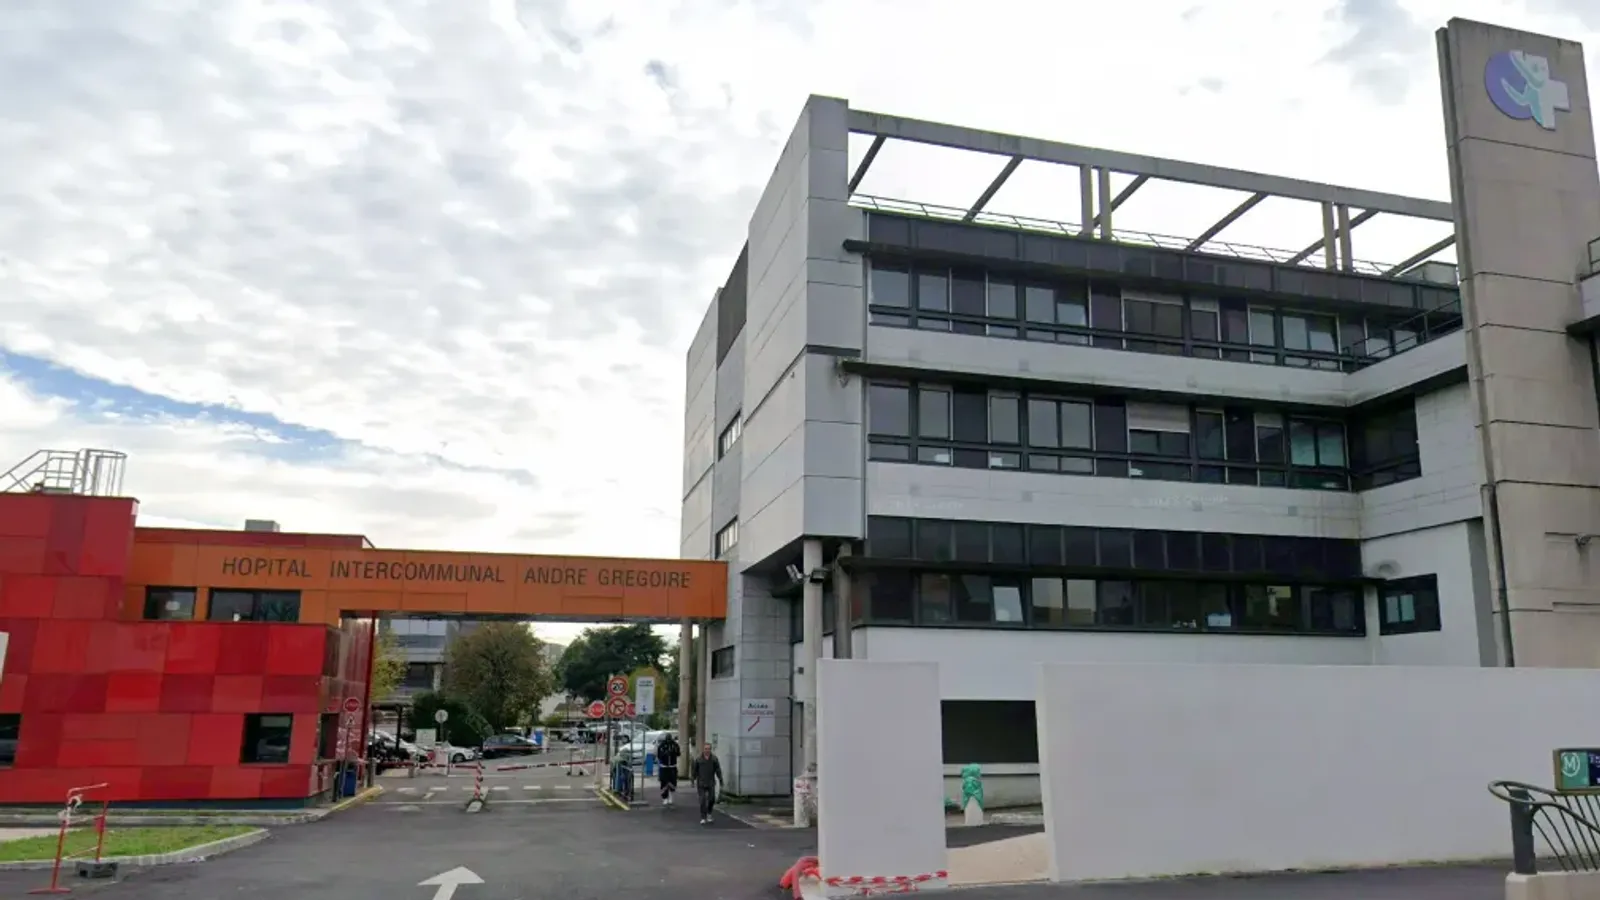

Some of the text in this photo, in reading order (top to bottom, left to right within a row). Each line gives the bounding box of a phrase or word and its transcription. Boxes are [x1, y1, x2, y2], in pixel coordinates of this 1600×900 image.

[222, 556, 692, 588] HOPITAL INTERCOMMUNAL ANDRE GREGOIRE
[613, 682, 625, 691] 20
